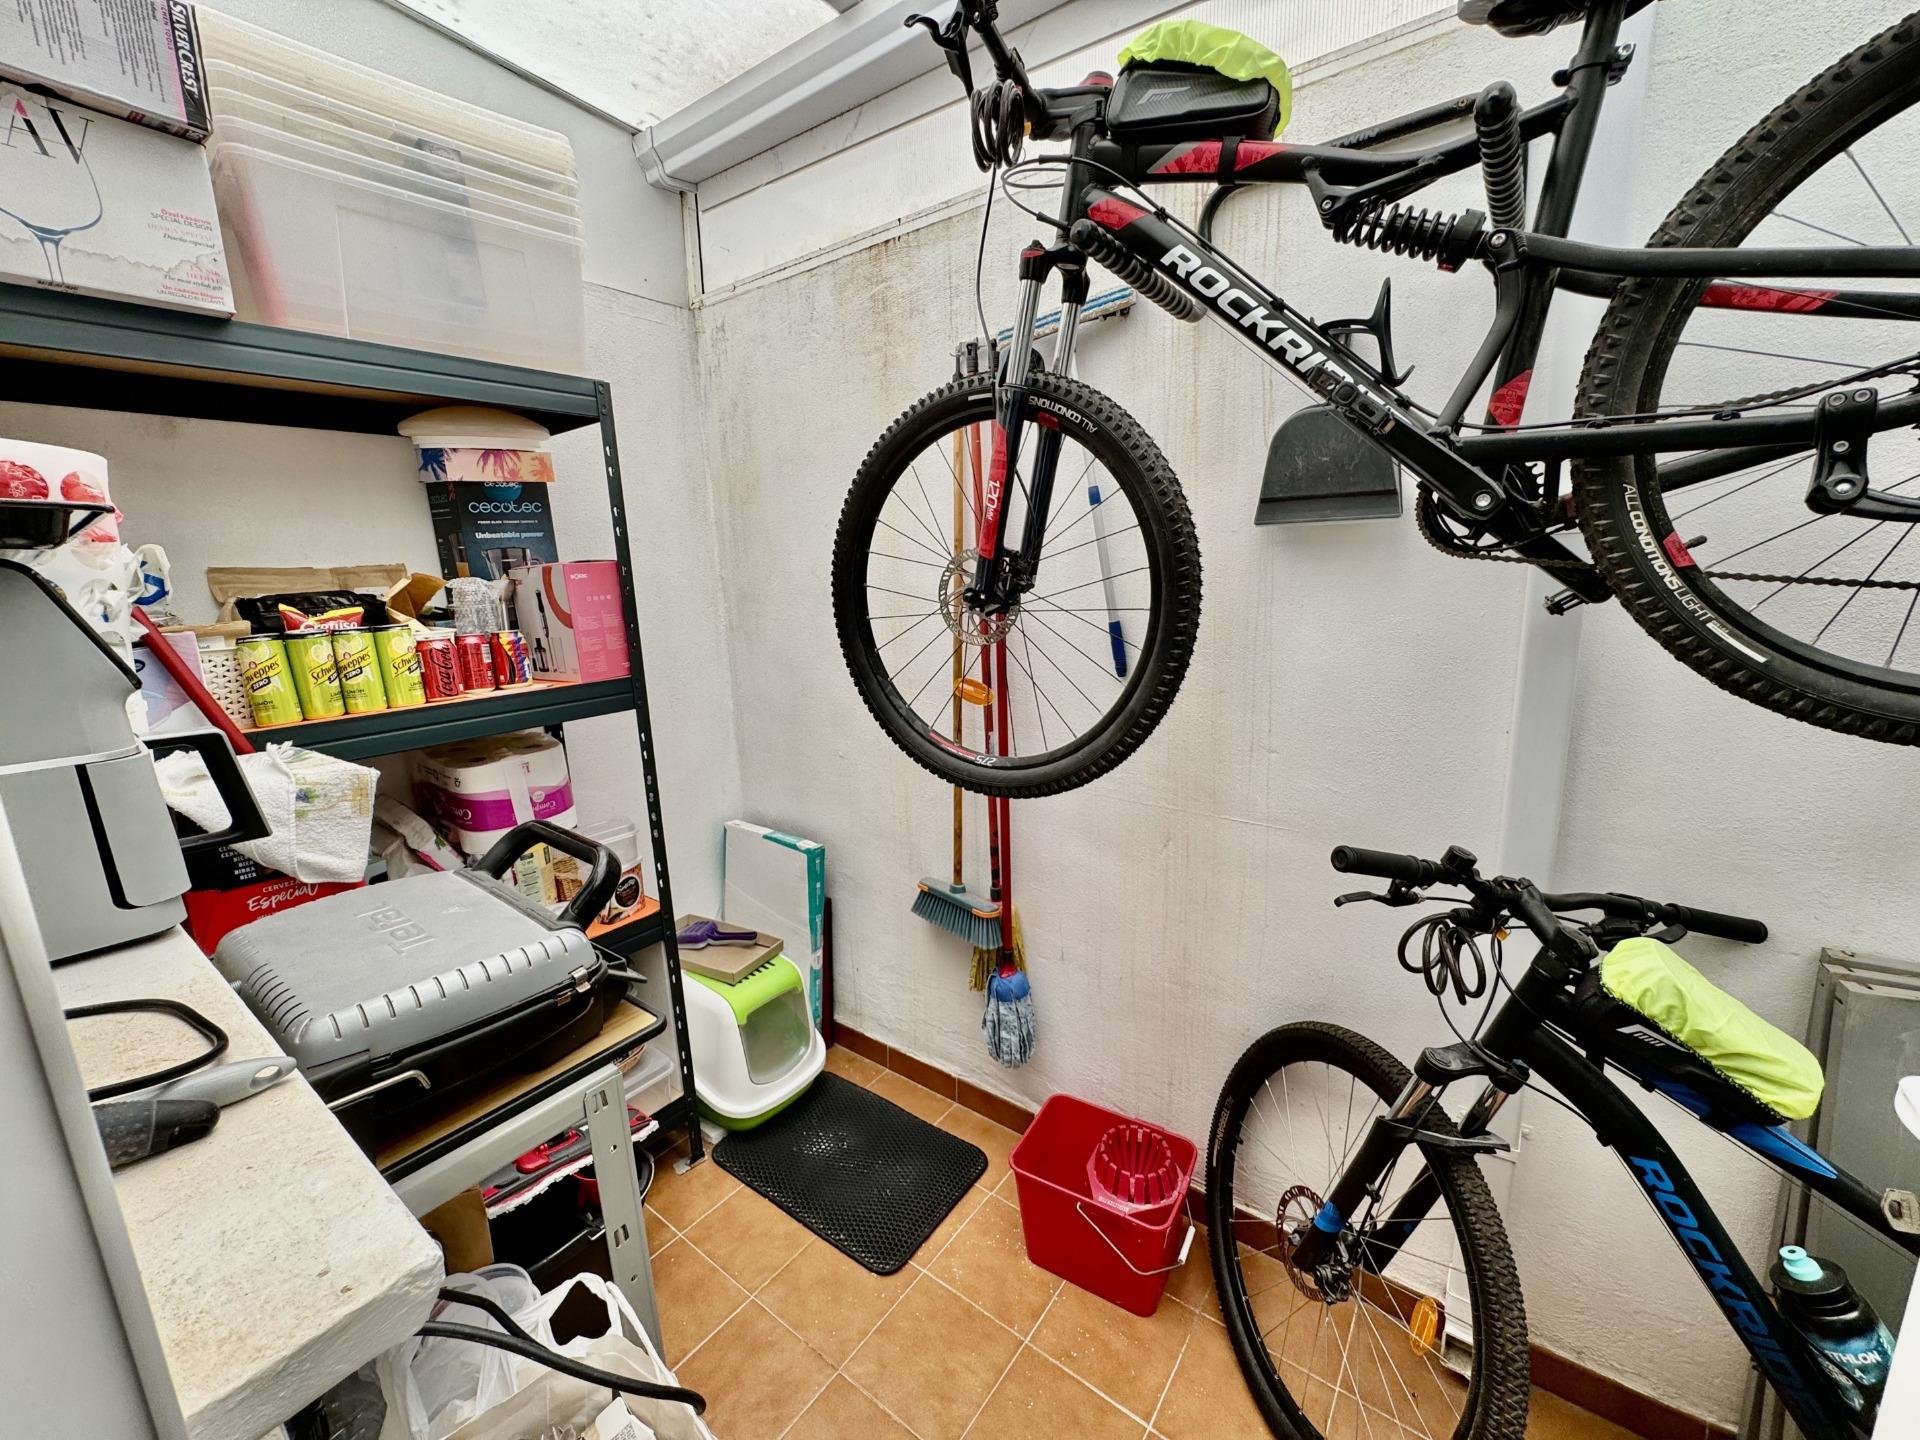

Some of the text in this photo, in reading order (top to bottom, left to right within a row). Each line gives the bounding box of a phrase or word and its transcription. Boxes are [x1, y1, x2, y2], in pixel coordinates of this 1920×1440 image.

[169, 2, 199, 96] SILVERCREST
[1160, 244, 1412, 427] ROCKRI
[1028, 395, 1098, 433] ALL CONDITIONS
[468, 501, 542, 513] cecotec
[1623, 483, 1715, 621] ALL CONDITIONS LIGHT
[234, 866, 256, 875] BIRRA
[239, 872, 257, 881] BEER
[246, 882, 319, 912] Especial
[1825, 1349, 1882, 1365] THLON
